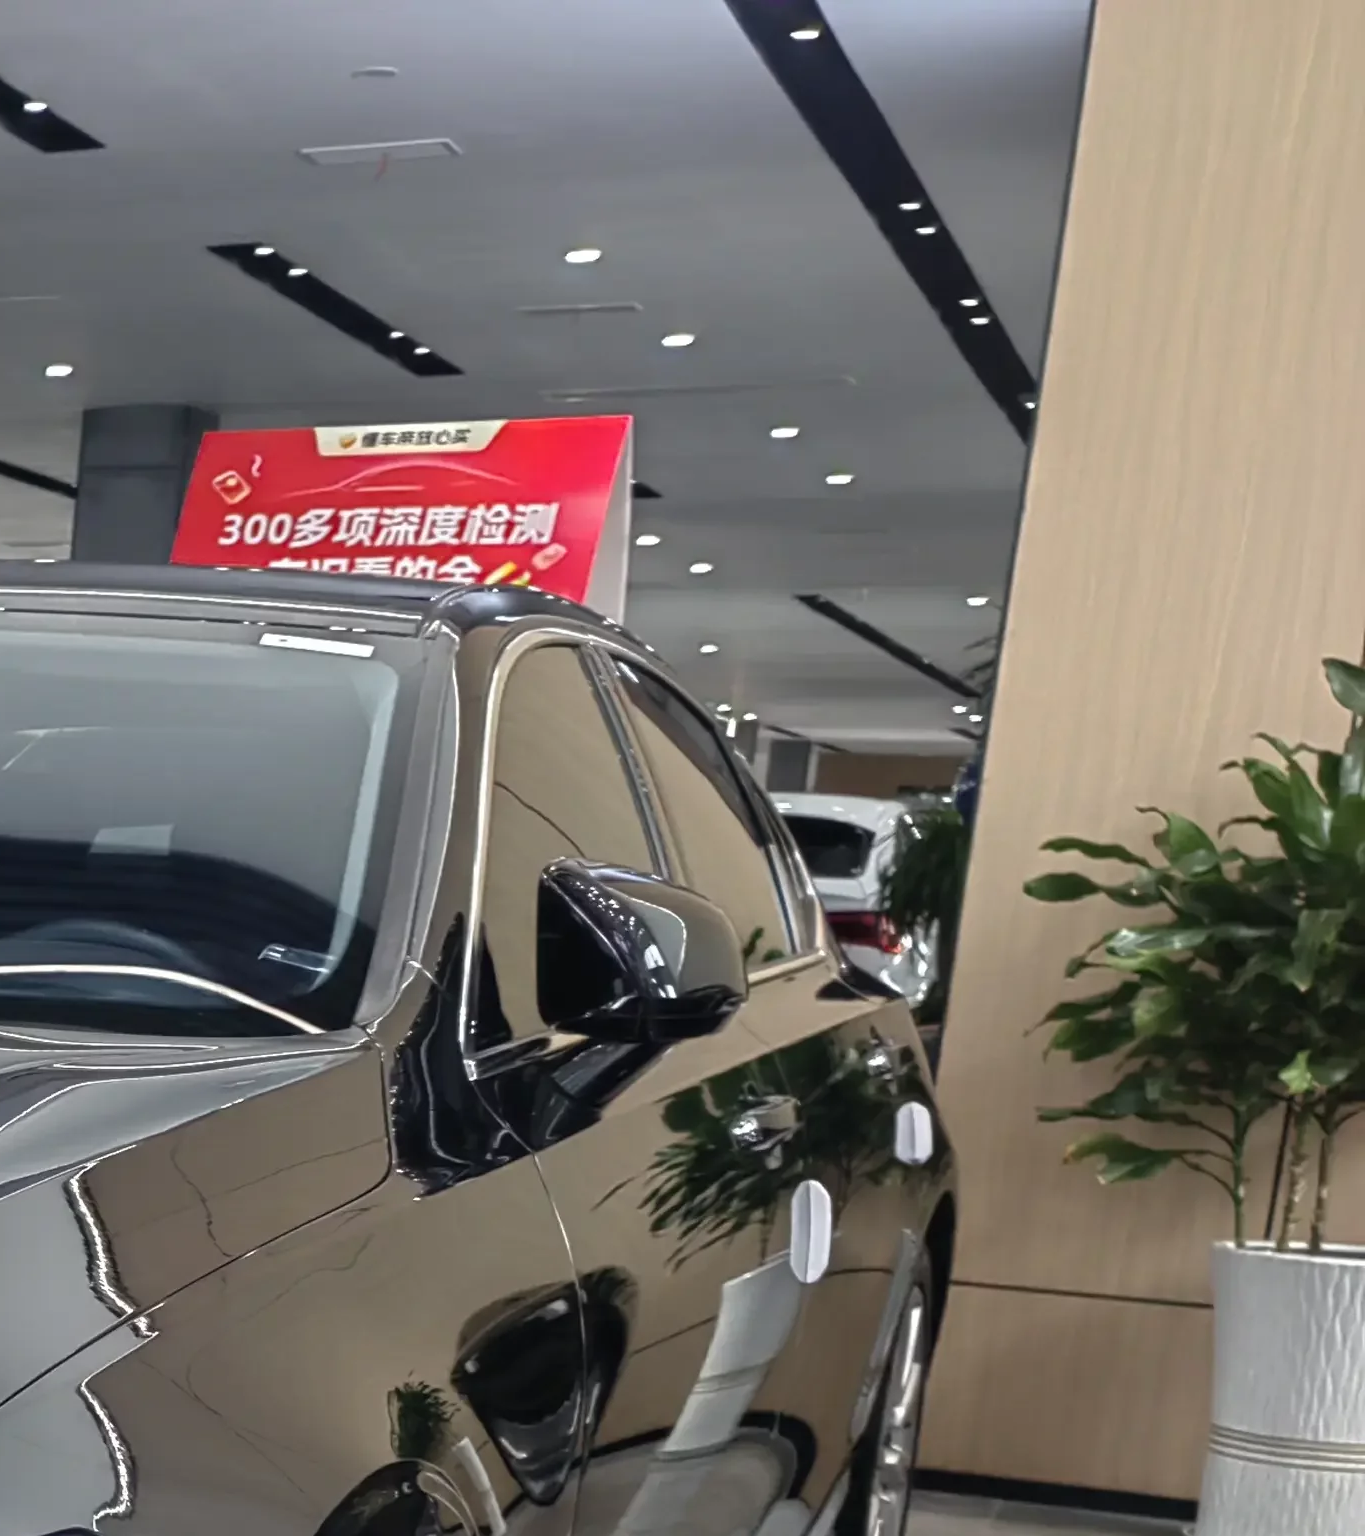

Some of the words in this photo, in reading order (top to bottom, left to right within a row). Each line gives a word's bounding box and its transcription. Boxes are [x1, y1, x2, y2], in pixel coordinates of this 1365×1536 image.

[217, 501, 560, 548] 300多项深度检测
